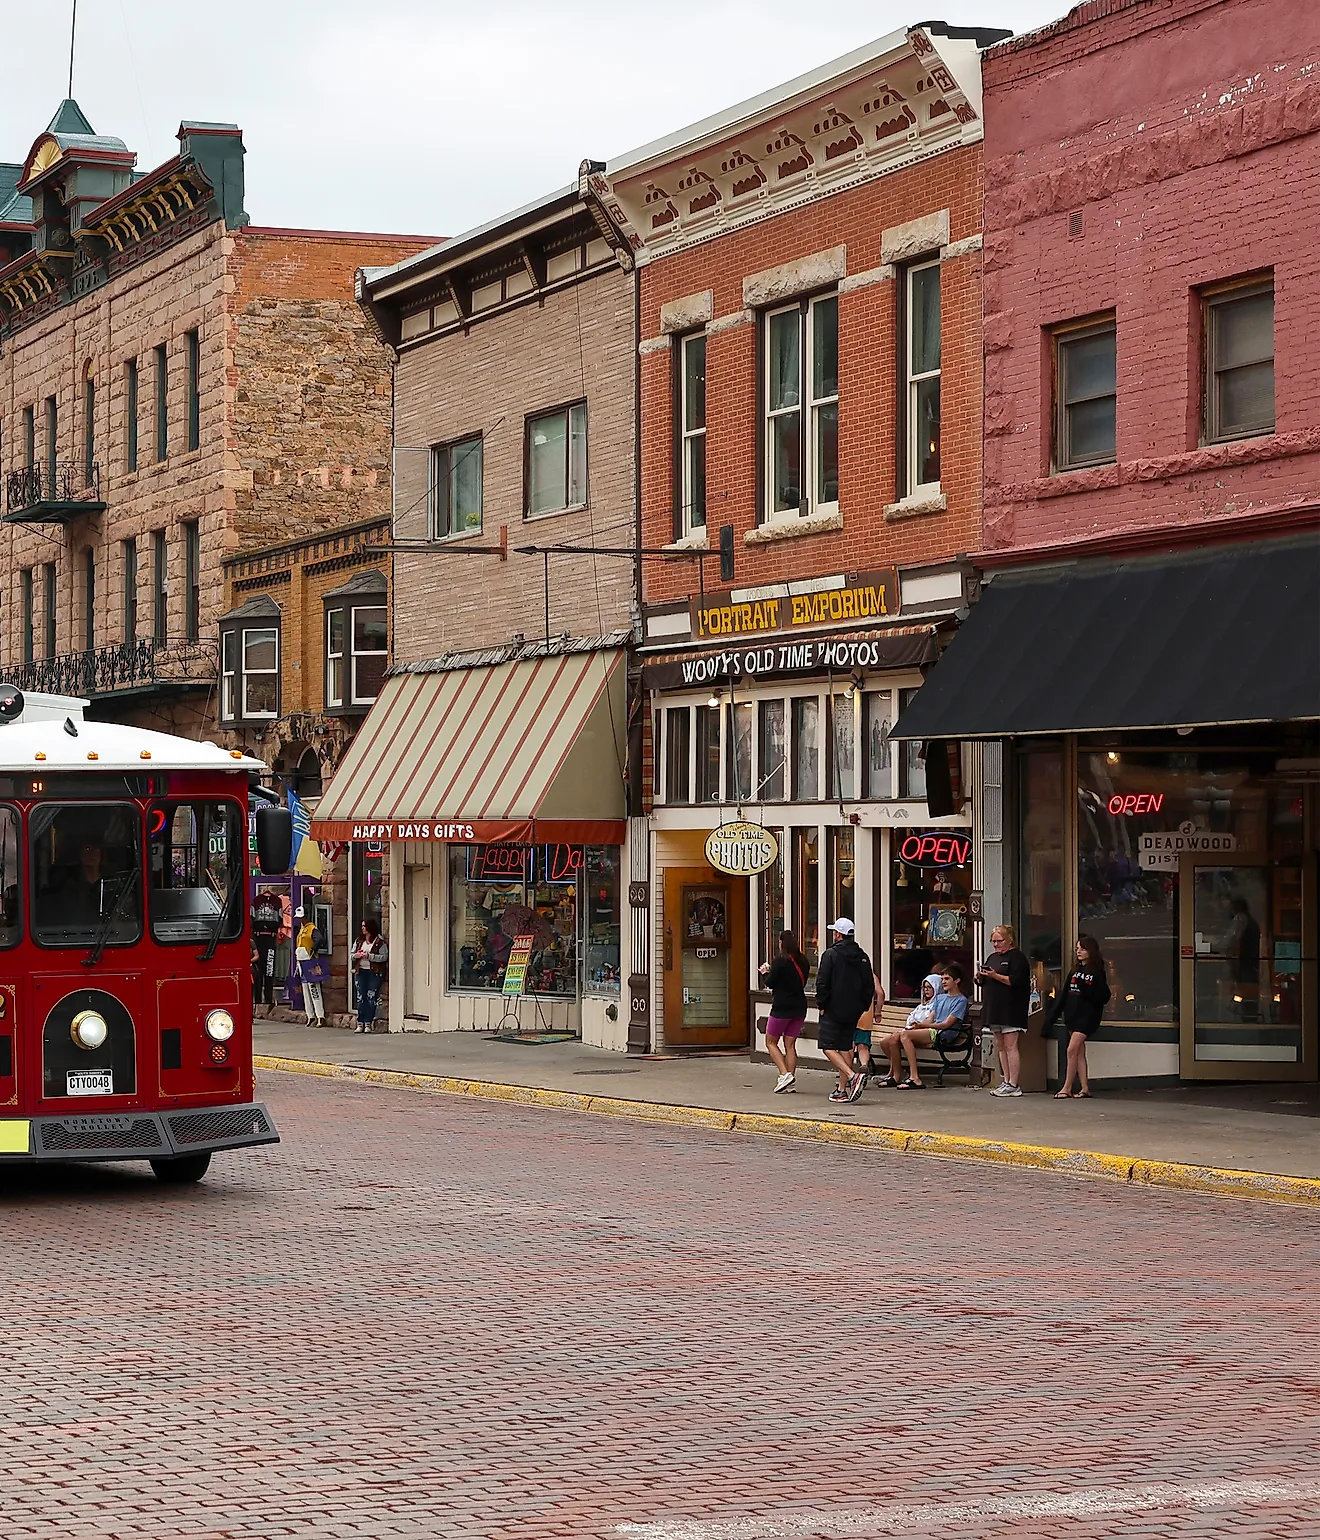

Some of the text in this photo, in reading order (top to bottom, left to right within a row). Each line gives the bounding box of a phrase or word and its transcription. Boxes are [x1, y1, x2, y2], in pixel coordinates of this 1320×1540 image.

[697, 585, 887, 635] PORTRAIT EMPORIUM
[744, 648, 775, 674] OLD
[778, 644, 814, 669] TIME
[817, 641, 880, 666] PHOTOS
[1108, 793, 1164, 815] OPEN
[353, 824, 475, 839] HAPPY DAYS GIFTS
[716, 830, 764, 839] OLD TIME
[901, 836, 969, 864] OPEN
[1144, 837, 1232, 850] DEADWOOD
[710, 841, 772, 871] PHOTOS
[1148, 855, 1179, 866] DIST
[697, 949, 716, 957] OPEN
[63, 1117, 130, 1125] HOMETOWN
[72, 1123, 124, 1131] TROLLEY
